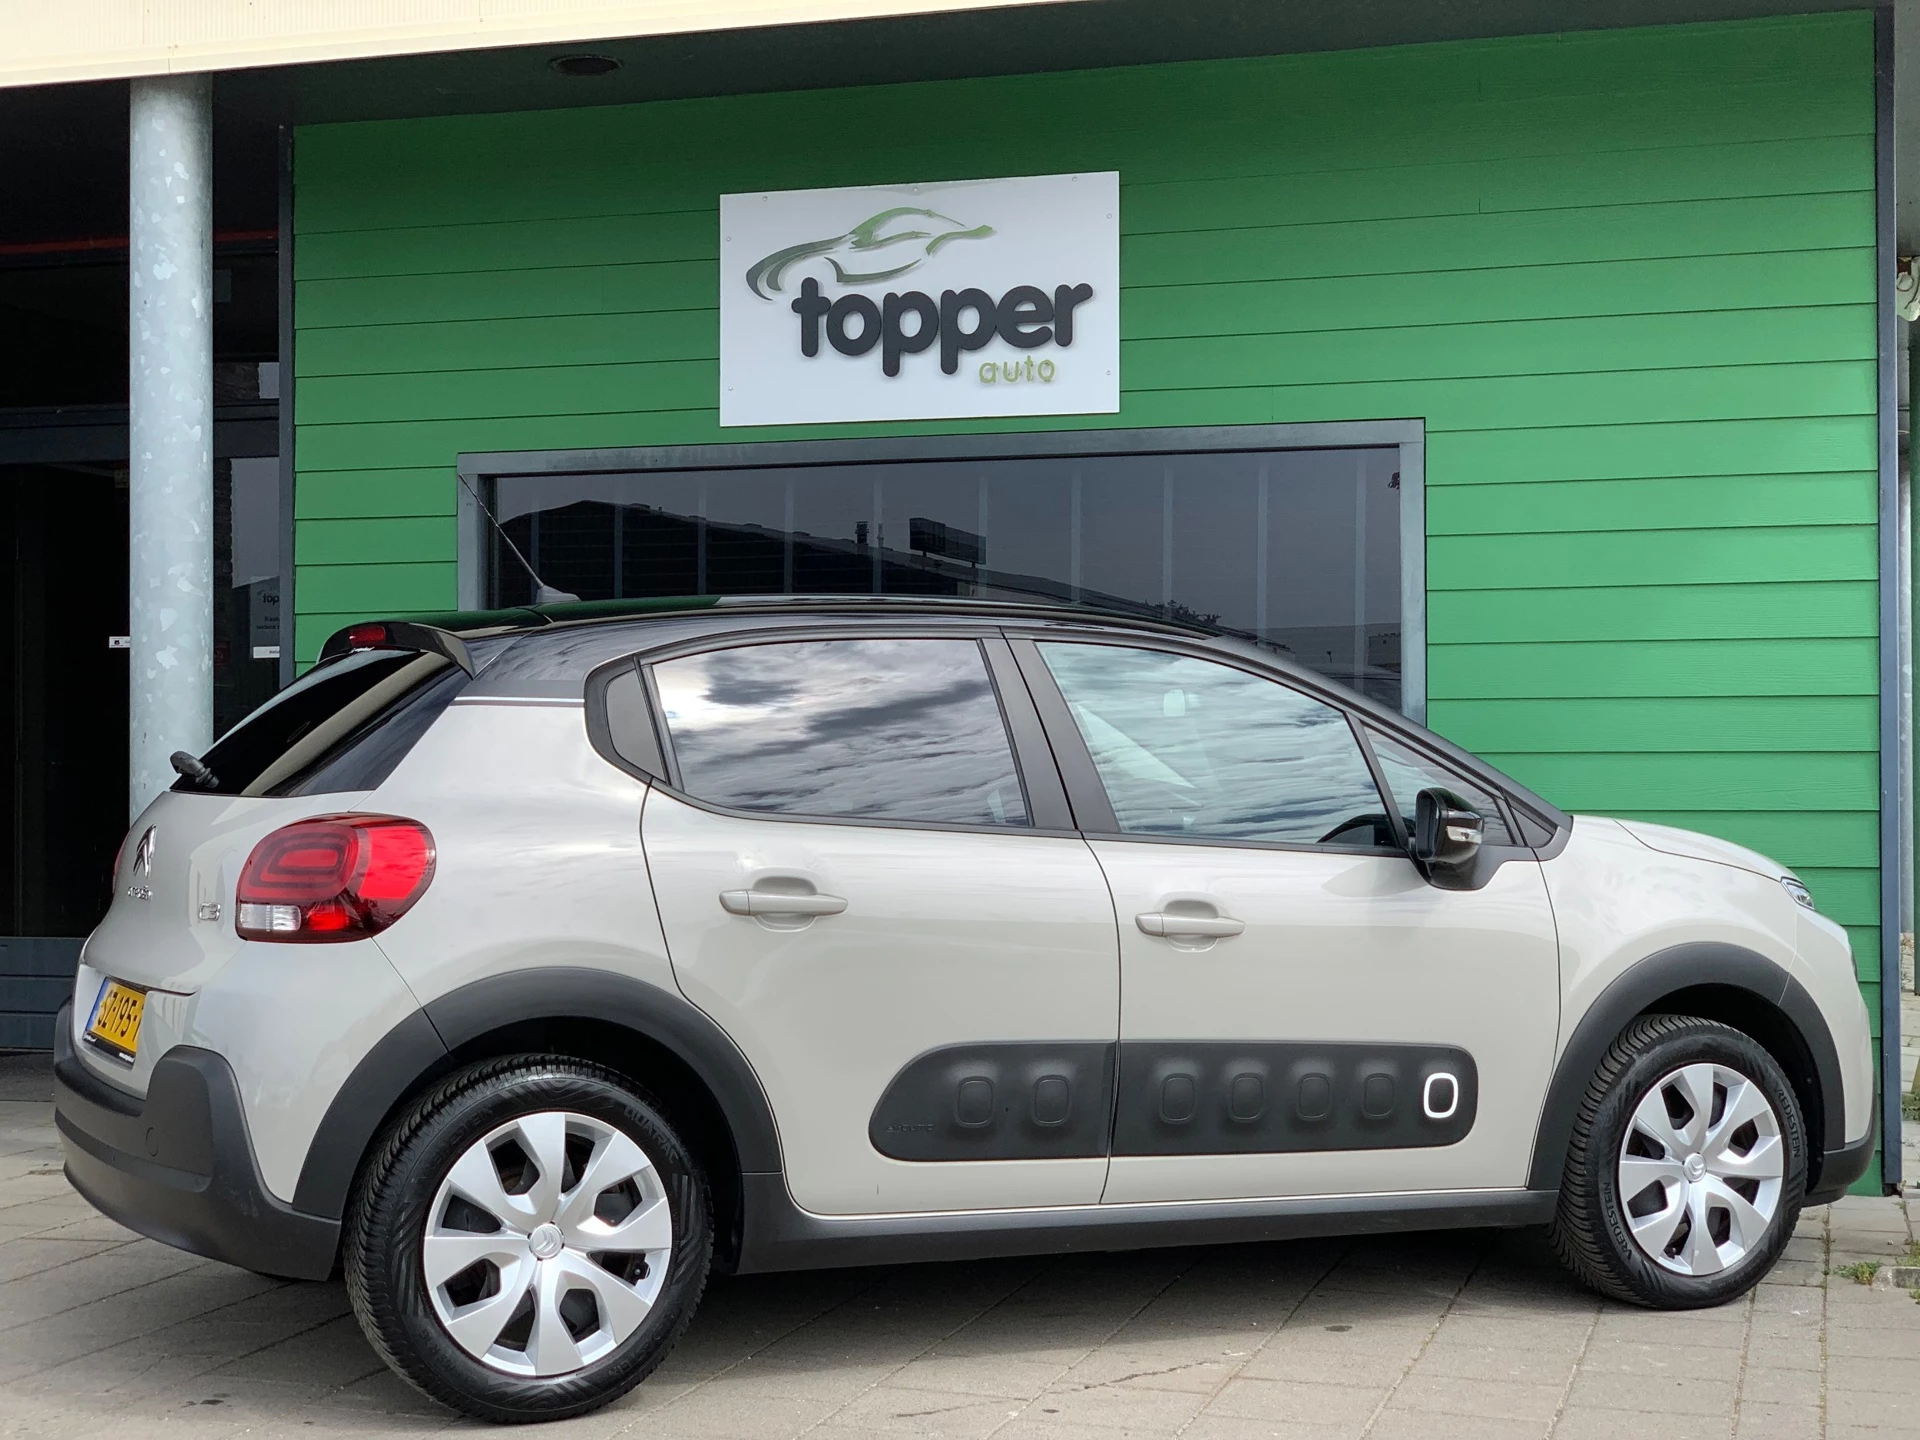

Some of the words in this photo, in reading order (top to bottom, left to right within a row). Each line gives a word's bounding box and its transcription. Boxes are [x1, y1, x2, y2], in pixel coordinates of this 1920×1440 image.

[791, 277, 1093, 377] topper
[979, 355, 1056, 383] auto
[97, 989, 146, 1042] SZ-195-
[623, 1105, 679, 1164] QUATRAC
[1603, 1181, 1633, 1261] VREDESTEIN
